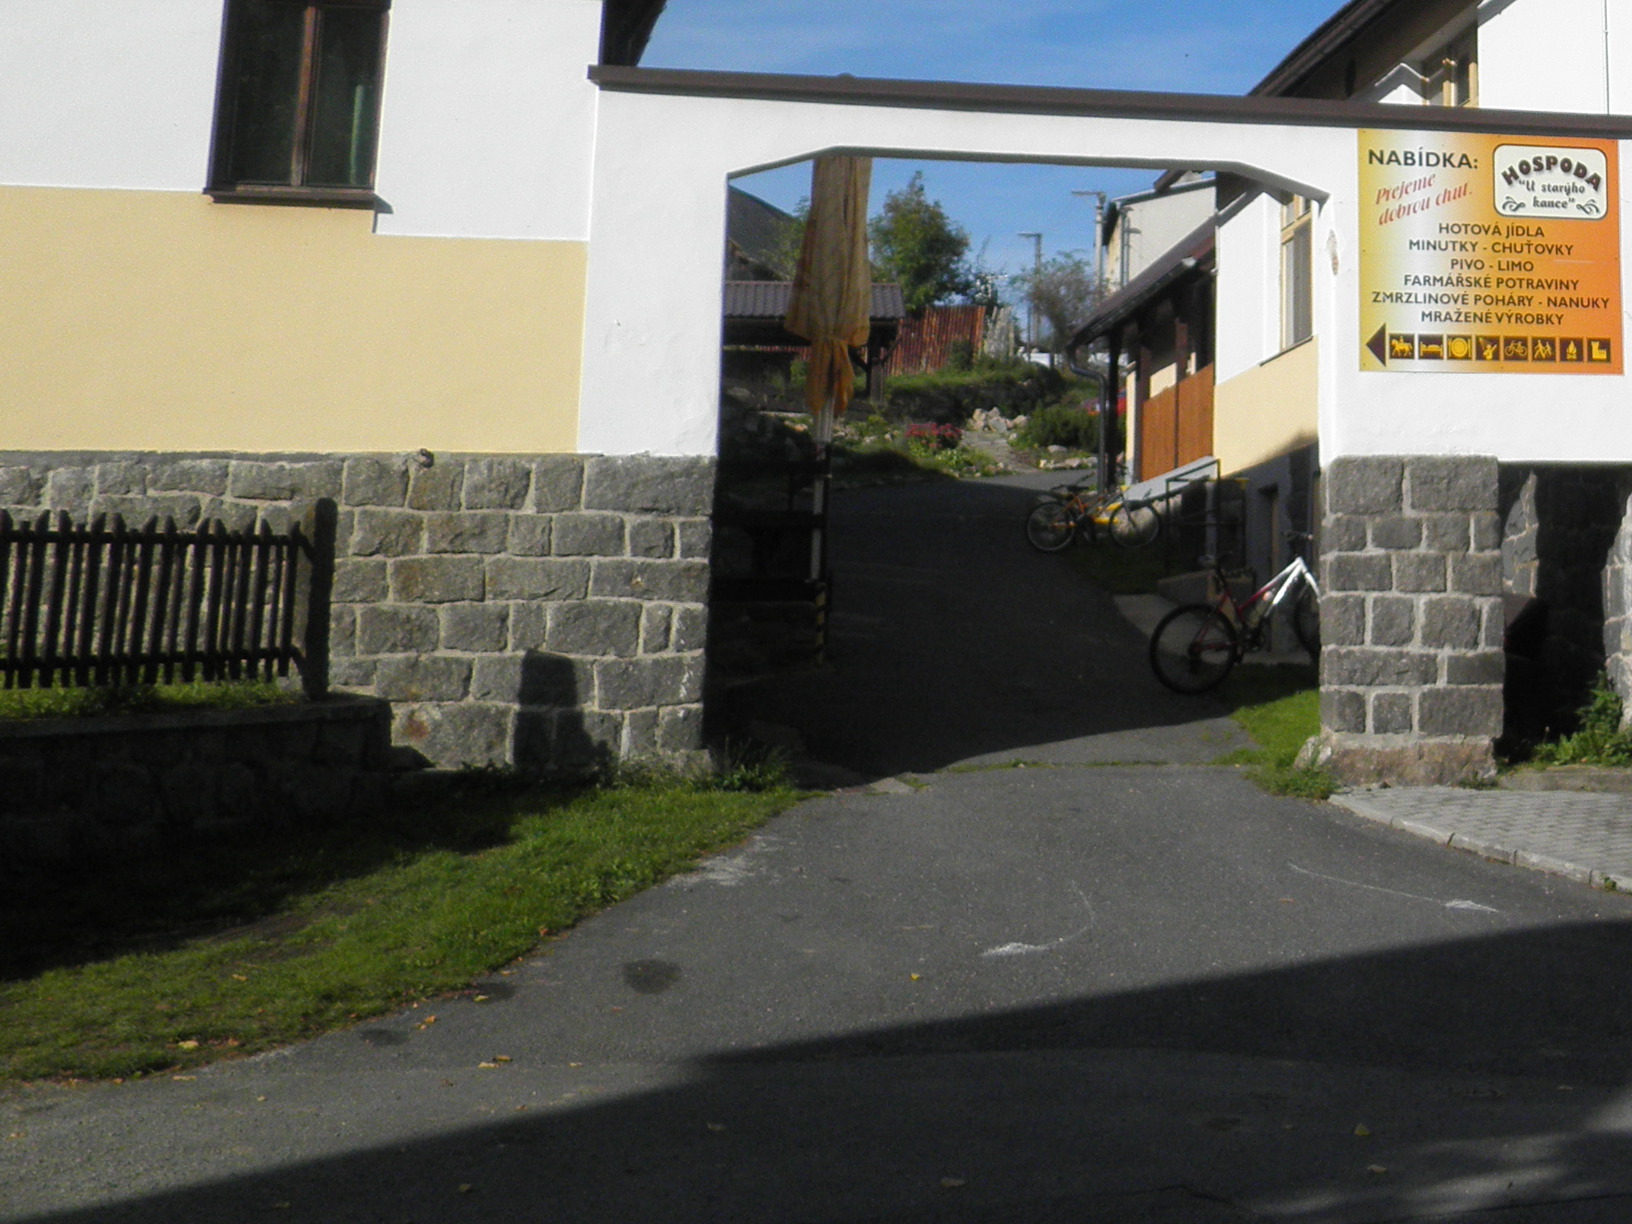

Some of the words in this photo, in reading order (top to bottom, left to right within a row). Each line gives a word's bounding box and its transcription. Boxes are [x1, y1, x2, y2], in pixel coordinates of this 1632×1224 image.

[1368, 147, 1478, 169] NABÍDKA:
[1501, 155, 1602, 192] HOSPODA
[1541, 181, 1585, 196] starýho
[1378, 196, 1431, 226] dobrou
[1438, 221, 1502, 236] HOTOVÁ
[1505, 222, 1545, 239] JÍDLA
[1408, 239, 1479, 253] MINUTKY
[1491, 240, 1574, 256] CHUŤOVKY
[1450, 258, 1486, 271] PIVO
[1497, 260, 1535, 272] LIMO
[1403, 272, 1493, 289] FARMÁŘSKÉ
[1496, 277, 1580, 291] POTRAVINY
[1371, 290, 1470, 305] ZMRZLINOVÉ
[1473, 291, 1534, 307] POHÁRY
[1547, 296, 1610, 309] NANUKY
[1420, 308, 1493, 324] MRAŽENÉ
[1495, 309, 1565, 325] VÝROBKY
